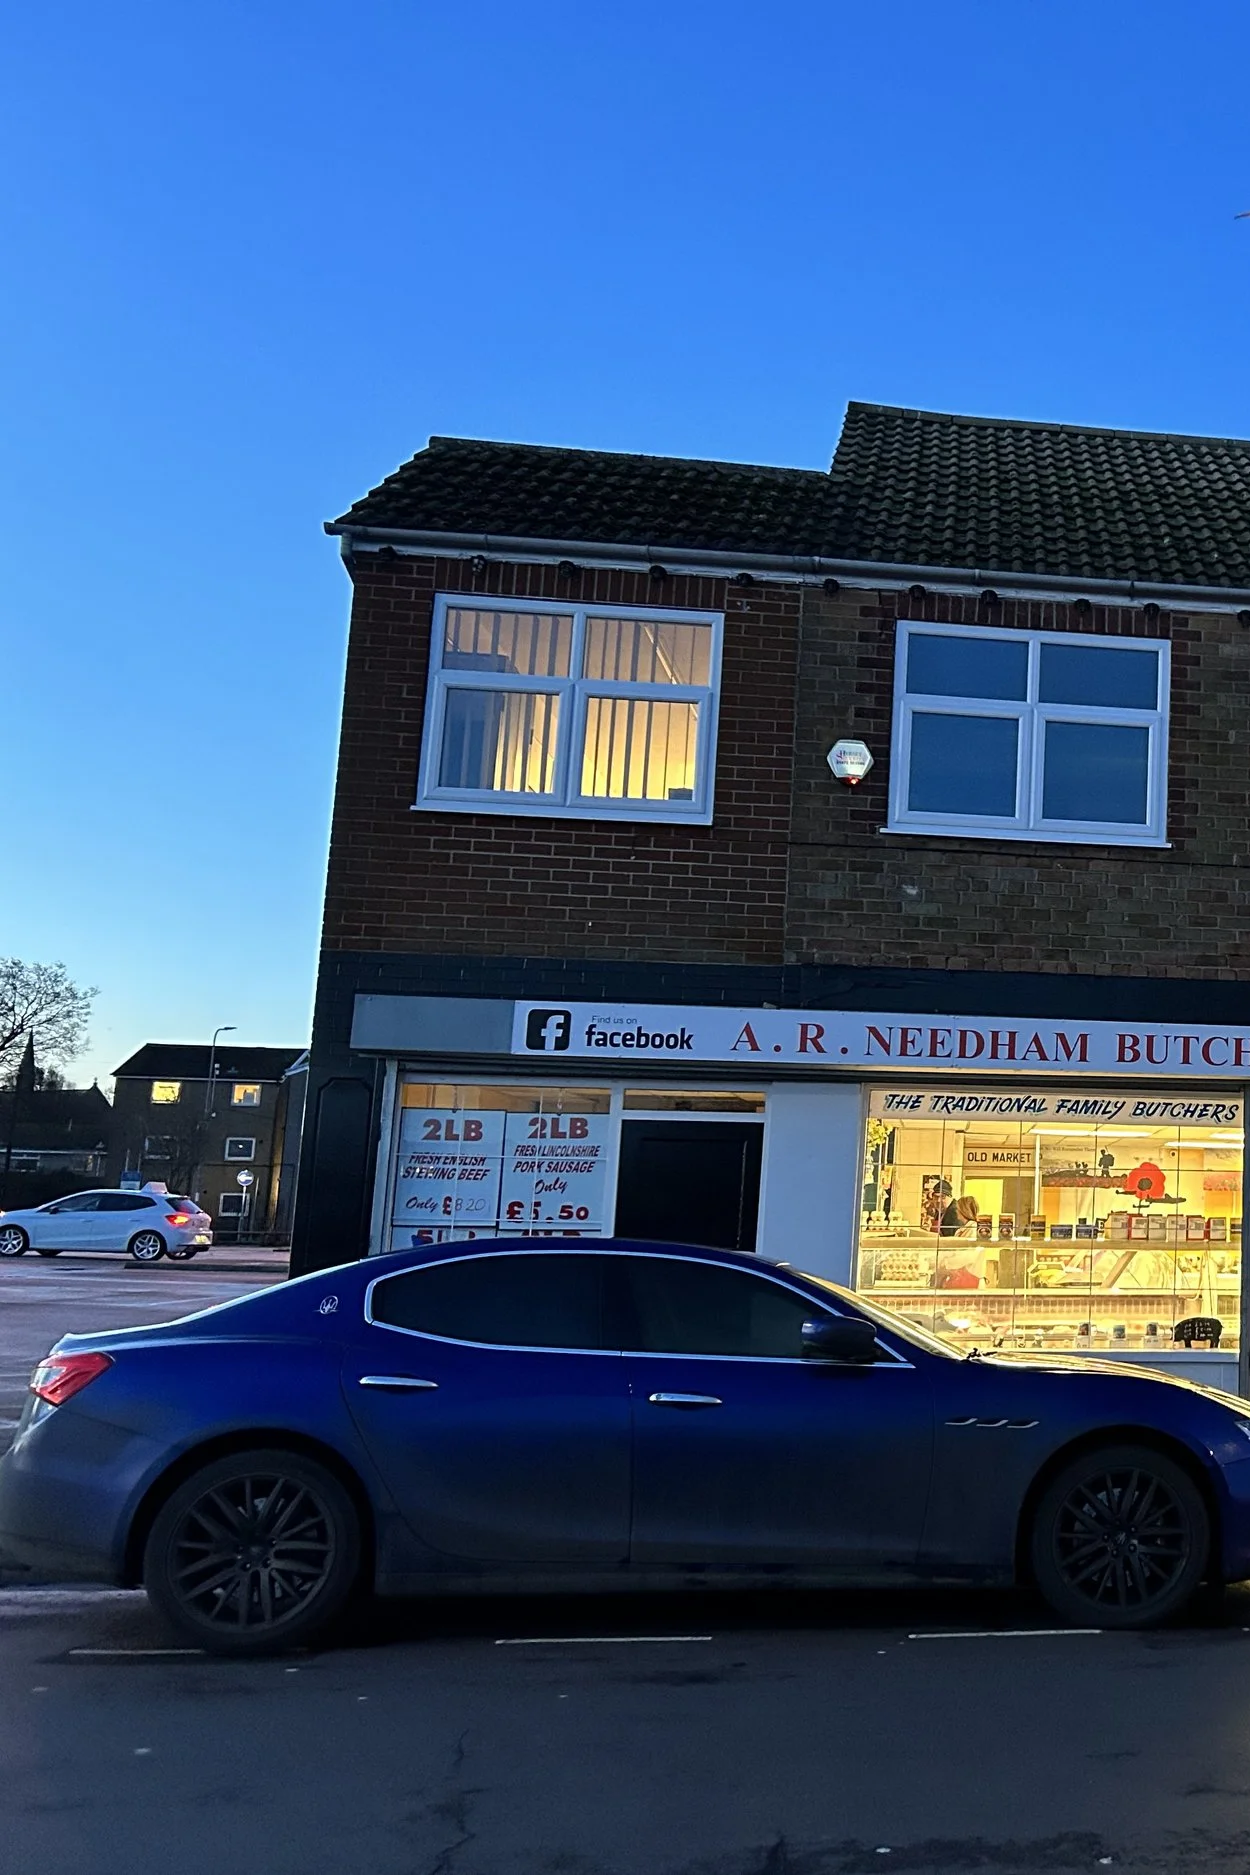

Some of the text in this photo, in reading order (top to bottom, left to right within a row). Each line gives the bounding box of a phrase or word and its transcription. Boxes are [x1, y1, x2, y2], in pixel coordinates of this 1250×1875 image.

[591, 1015, 611, 1024] Find
[585, 1024, 694, 1050] facebook
[864, 1025, 1091, 1063] NEEDHAM
[884, 1093, 921, 1111] THE
[1133, 1100, 1240, 1123] BUTCHERS
[421, 1118, 484, 1142] 2LB
[527, 1117, 589, 1139] 2LB
[408, 1151, 442, 1165] FRESH
[541, 1145, 601, 1157] LINCOLNSHIRE
[967, 1152, 988, 1162] OLD
[992, 1152, 1032, 1163] MARKET
[457, 1168, 491, 1181] BEEF
[513, 1160, 596, 1173] PORK SAUSAGE
[535, 1177, 568, 1195] Only
[405, 1196, 439, 1213] Only
